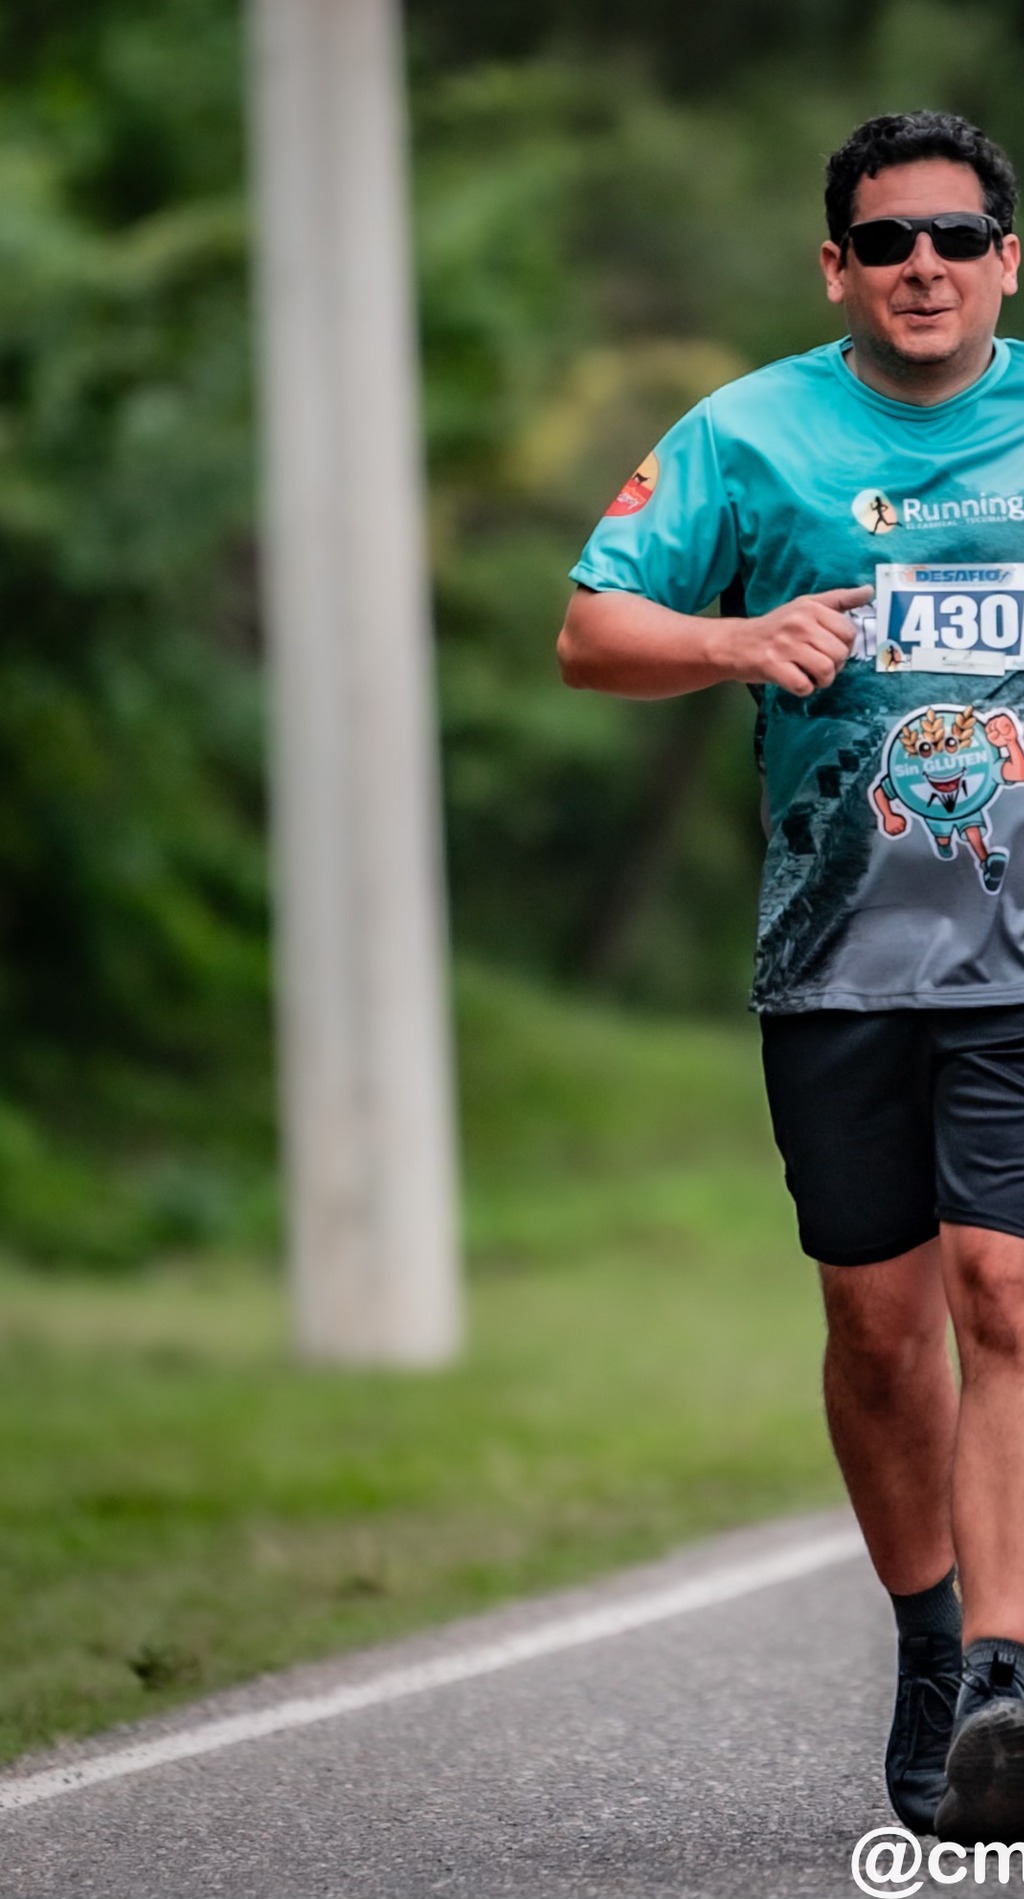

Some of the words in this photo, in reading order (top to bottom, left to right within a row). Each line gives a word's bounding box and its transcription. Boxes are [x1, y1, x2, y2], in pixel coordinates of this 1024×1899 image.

[915, 569, 1000, 583] DESAFIO
[900, 594, 1019, 650] 430
[894, 763, 919, 777] Sin
[923, 750, 988, 772] GLUTEN
